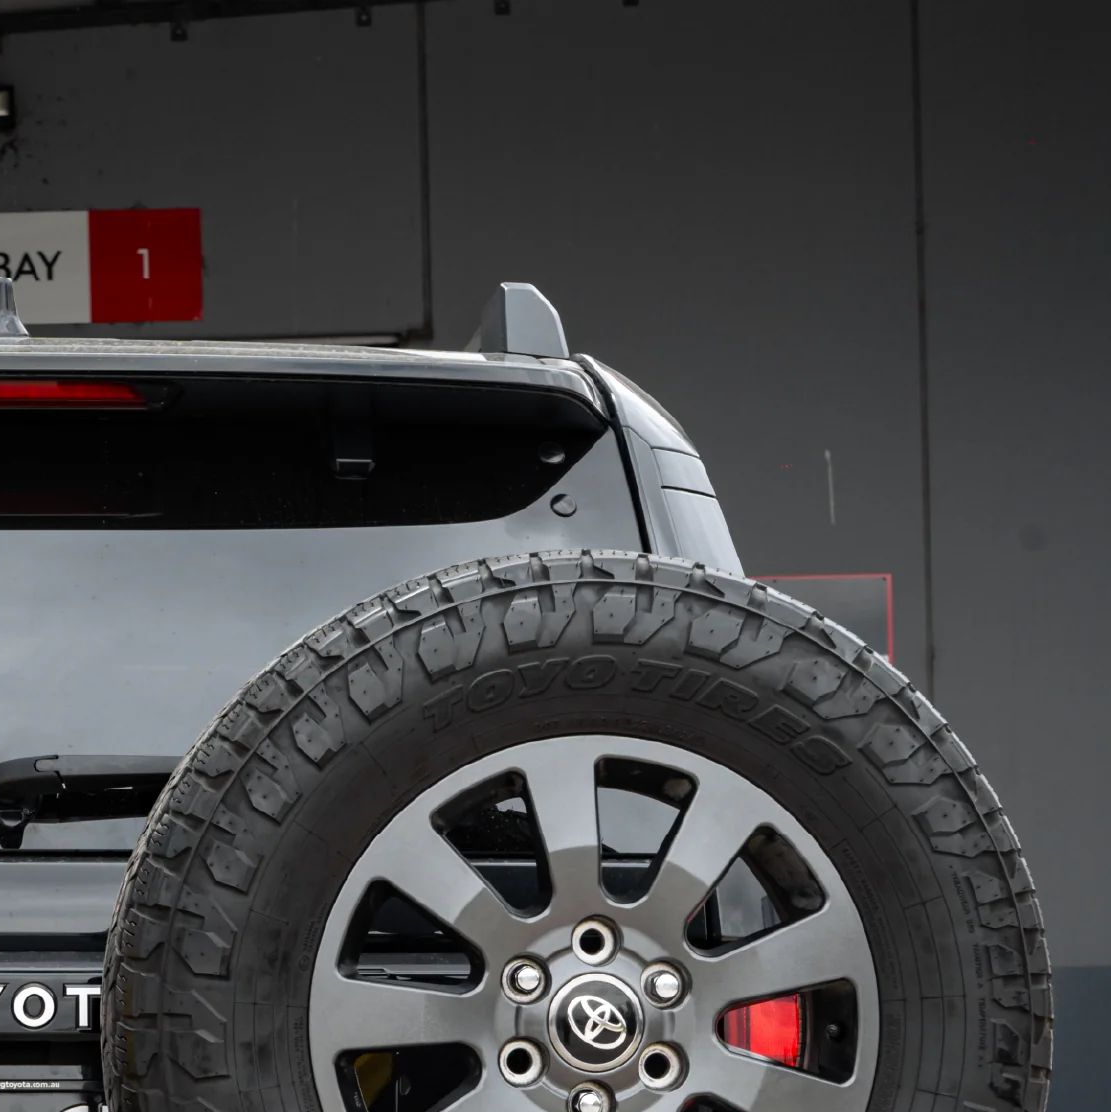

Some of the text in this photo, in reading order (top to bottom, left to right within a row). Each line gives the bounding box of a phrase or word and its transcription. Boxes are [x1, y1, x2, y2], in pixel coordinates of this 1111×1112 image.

[136, 248, 150, 279] 1
[423, 654, 854, 776] TOYO TIRES
